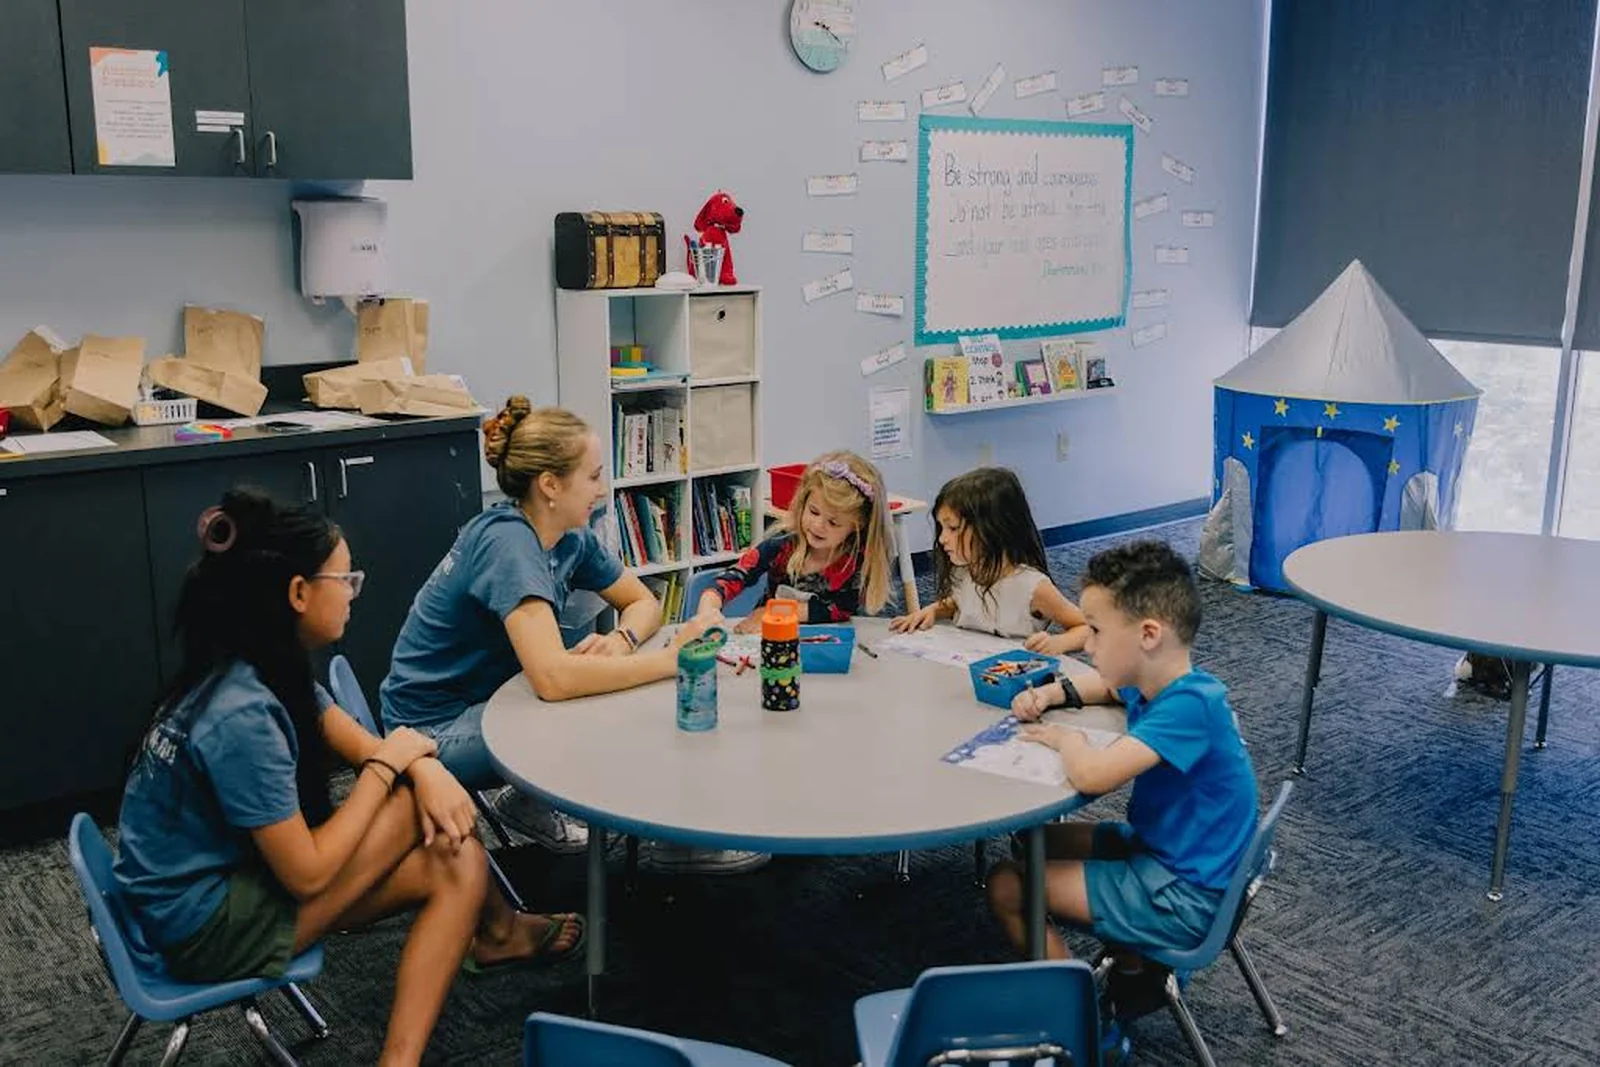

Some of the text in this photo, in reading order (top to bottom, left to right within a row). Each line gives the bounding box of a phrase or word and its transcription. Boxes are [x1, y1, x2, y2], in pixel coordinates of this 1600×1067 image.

[944, 152, 961, 187] Be
[968, 160, 1013, 197] strong
[1016, 152, 1039, 186] and
